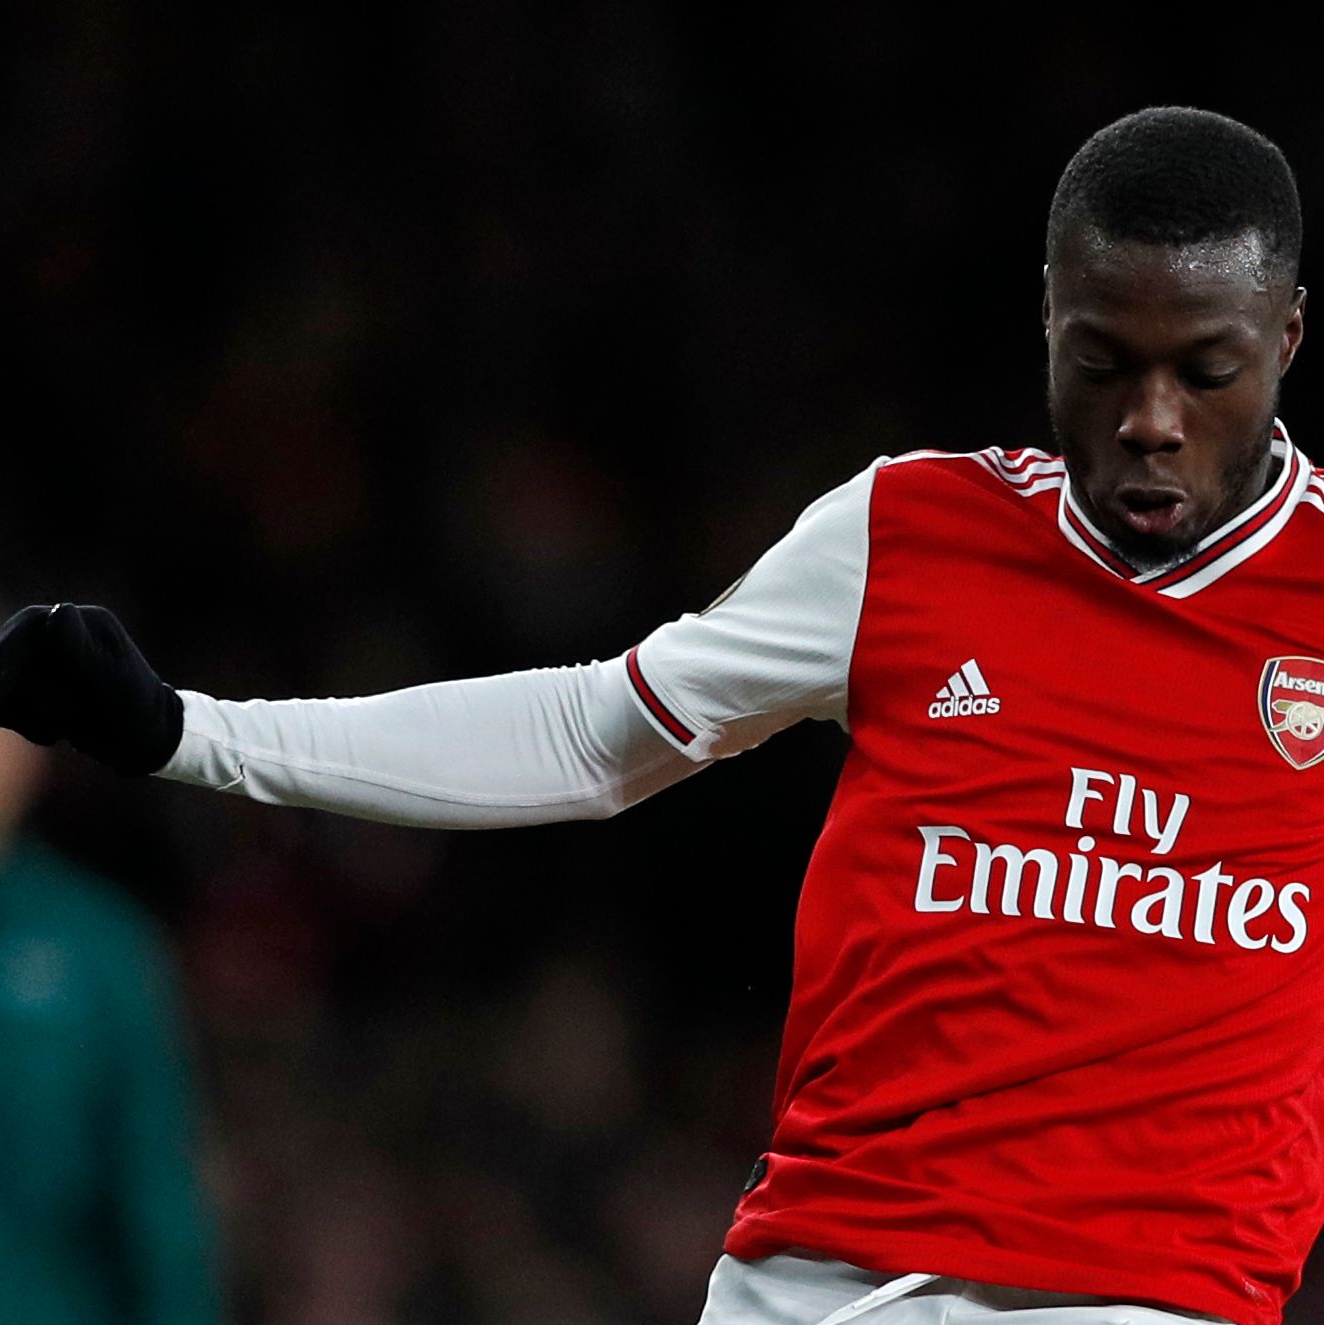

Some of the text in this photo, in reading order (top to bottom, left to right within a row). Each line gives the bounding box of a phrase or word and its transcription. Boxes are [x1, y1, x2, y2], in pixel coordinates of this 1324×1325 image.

[928, 694, 1001, 719] adidas
[1064, 766, 1191, 856] Fly
[913, 825, 1312, 955] Emirates
